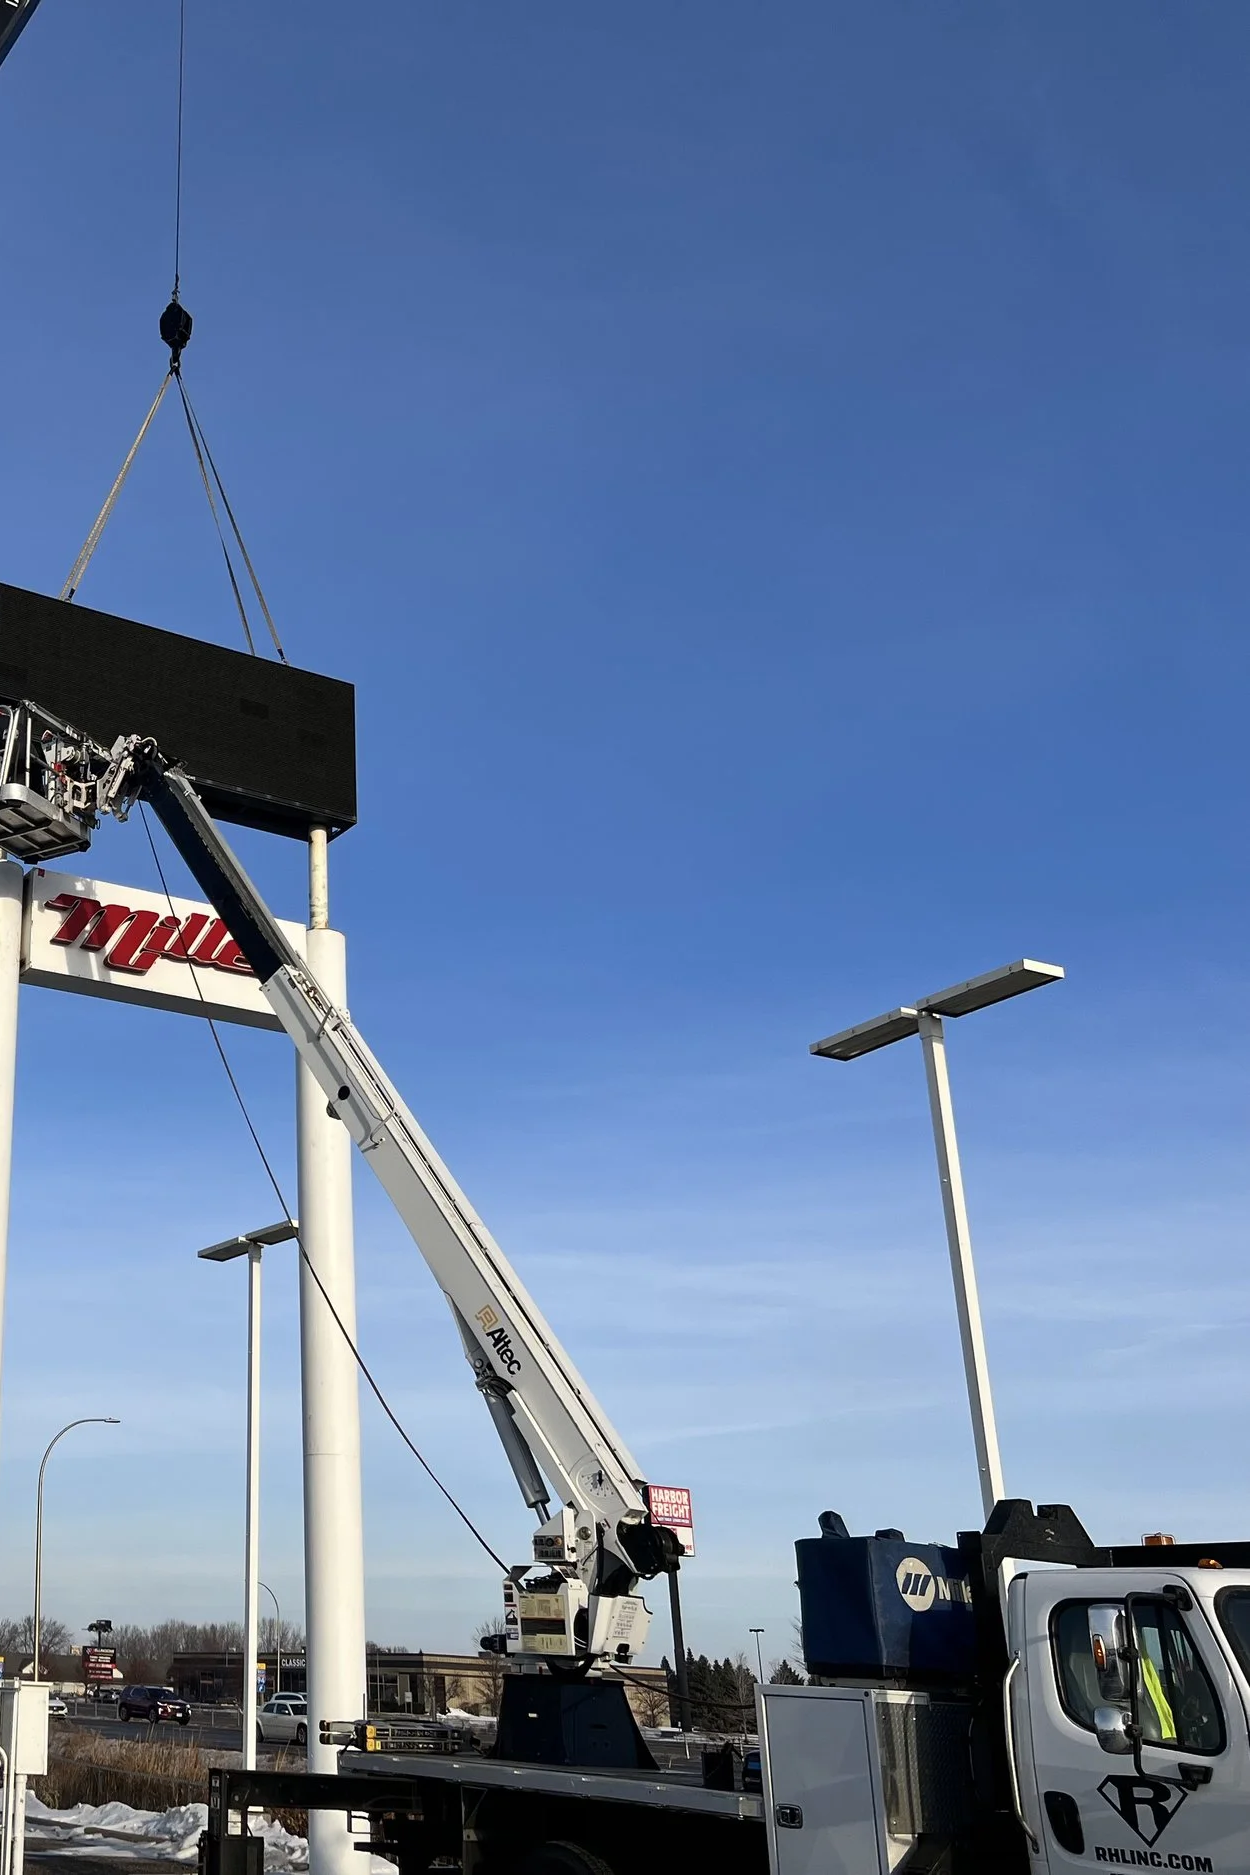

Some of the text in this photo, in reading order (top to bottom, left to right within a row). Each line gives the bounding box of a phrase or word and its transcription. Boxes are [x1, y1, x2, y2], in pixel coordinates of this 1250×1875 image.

[44, 893, 260, 977] Mille
[486, 1327, 521, 1375] Altec
[651, 1488, 689, 1505] HARBOR
[651, 1502, 690, 1518] FREIGHT
[281, 1658, 306, 1667] CLASSIC
[1094, 1846, 1214, 1873] RHLINC.COM
